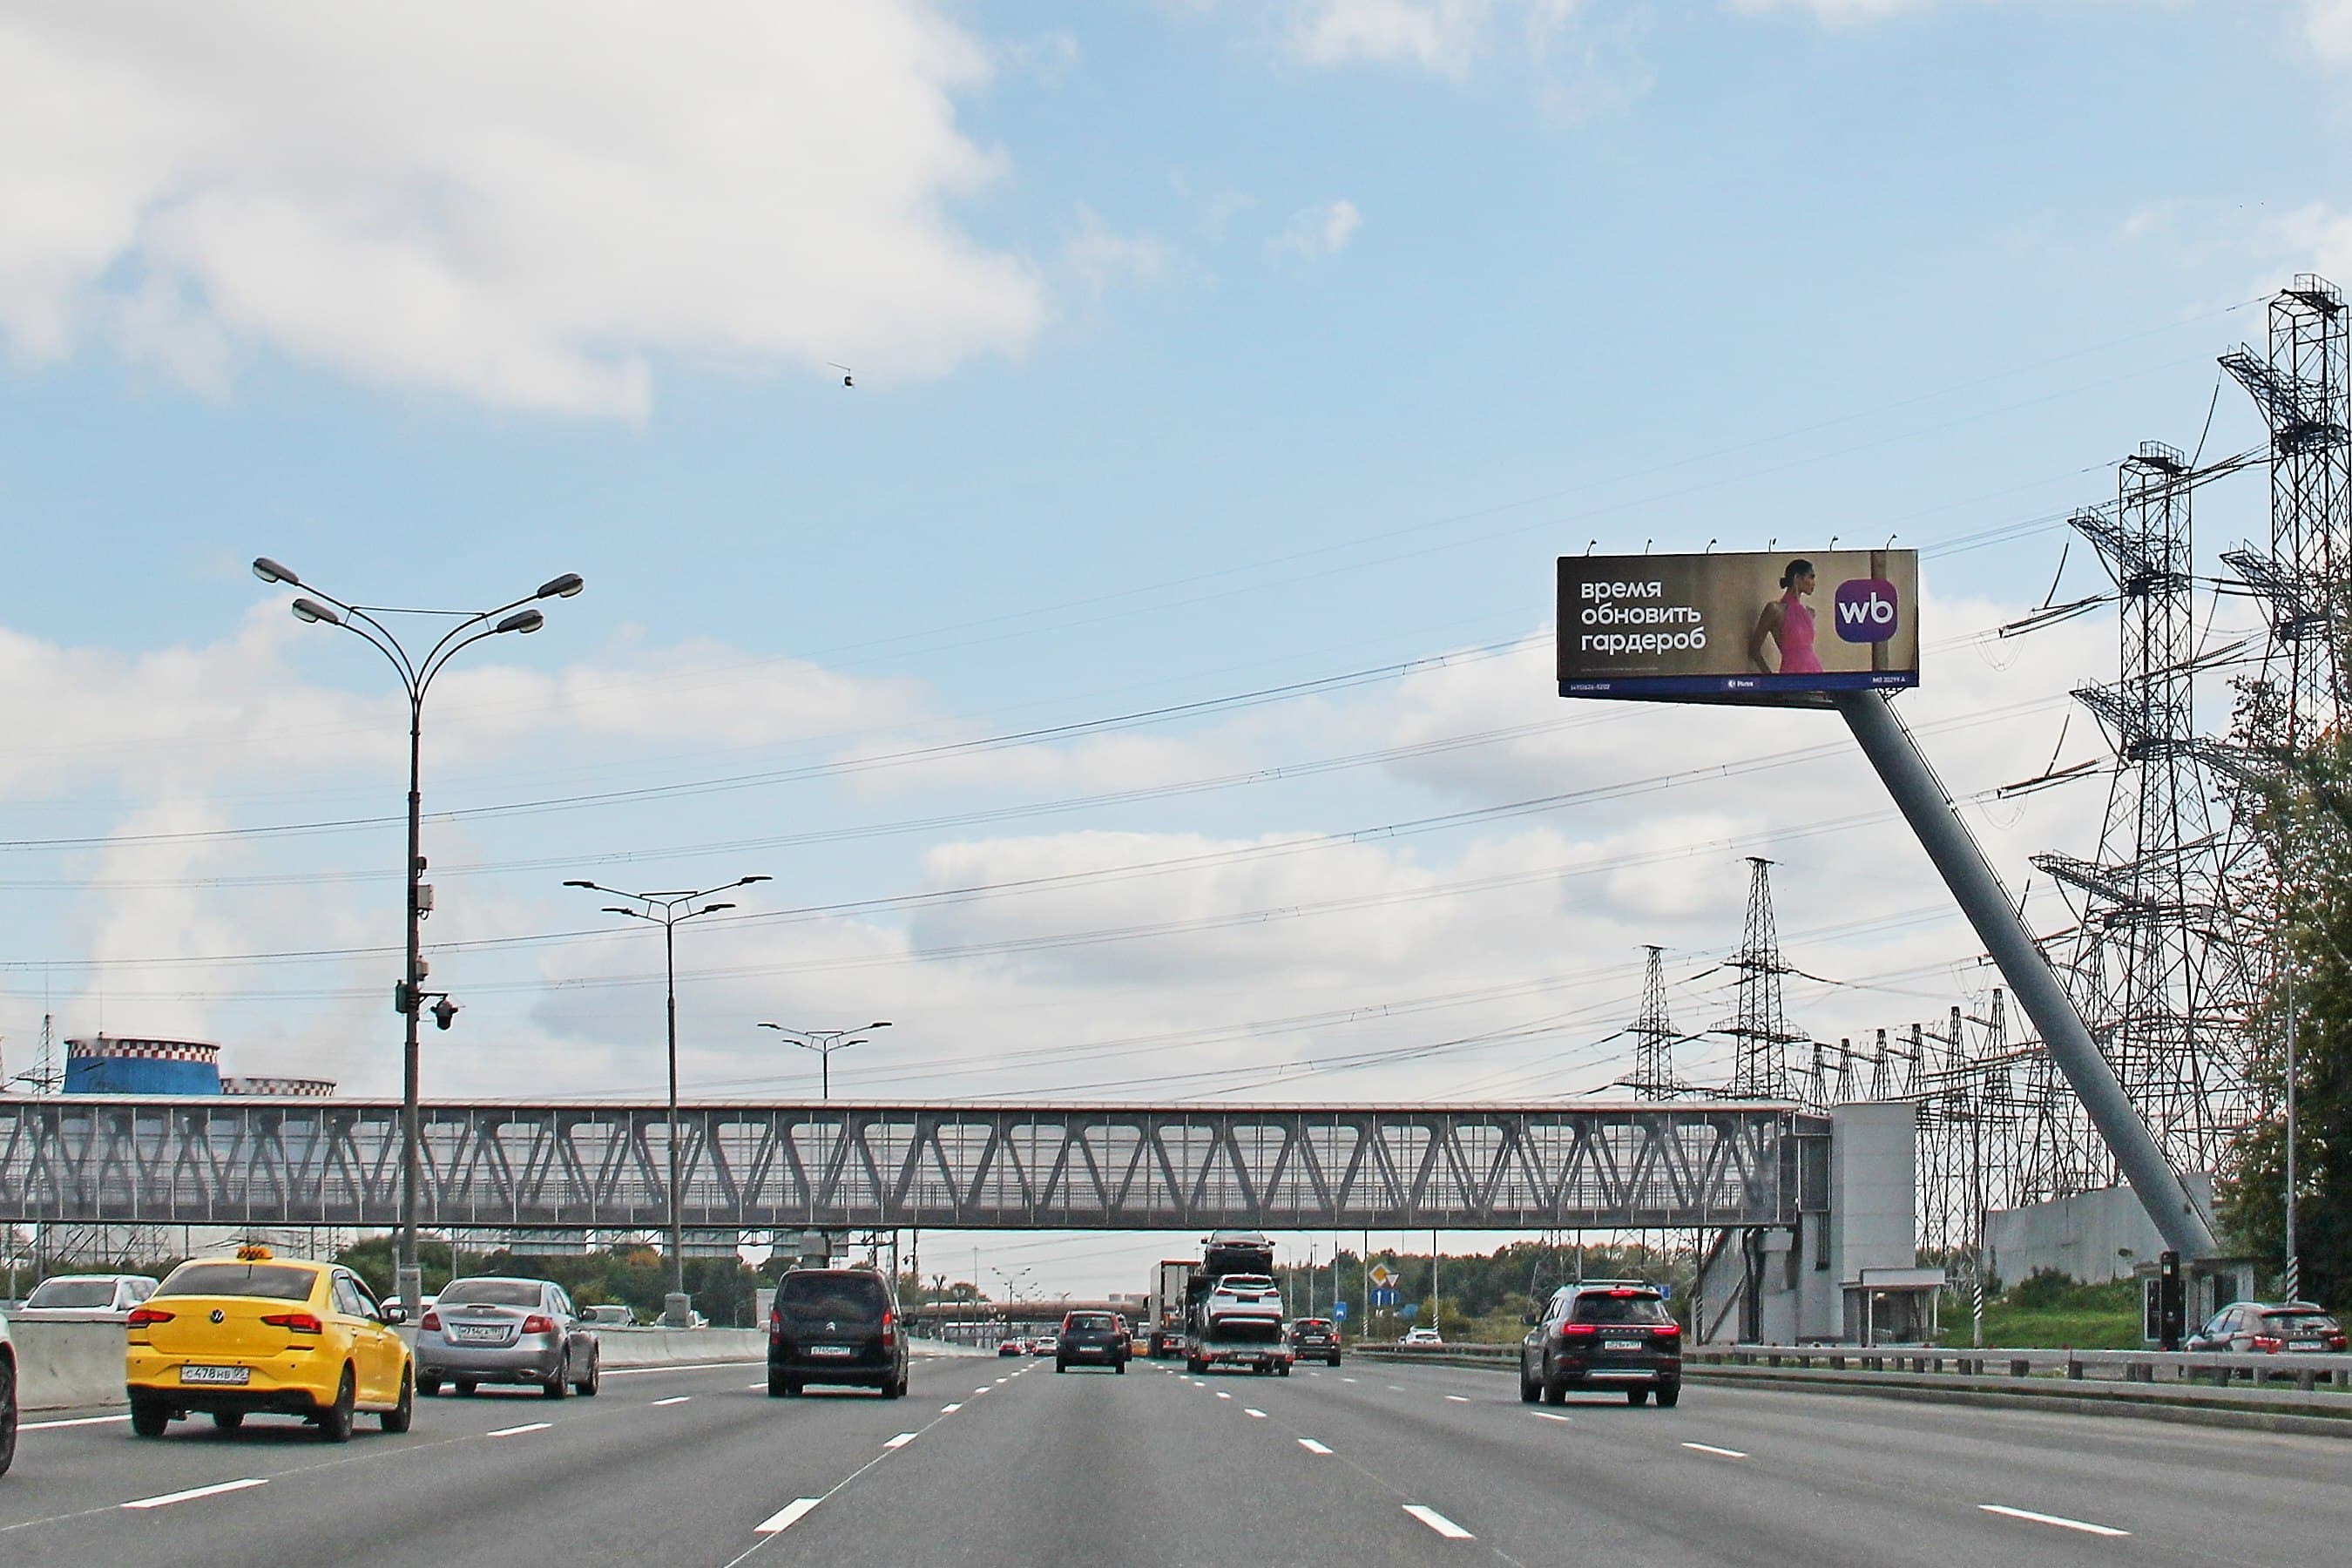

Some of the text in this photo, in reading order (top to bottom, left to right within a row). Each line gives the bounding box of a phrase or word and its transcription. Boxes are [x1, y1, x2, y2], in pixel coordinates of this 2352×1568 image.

[1581, 581, 1662, 604] время
[1581, 602, 1702, 625] обновить
[1838, 591, 1894, 624] wb
[1581, 626, 1707, 656] гардероб
